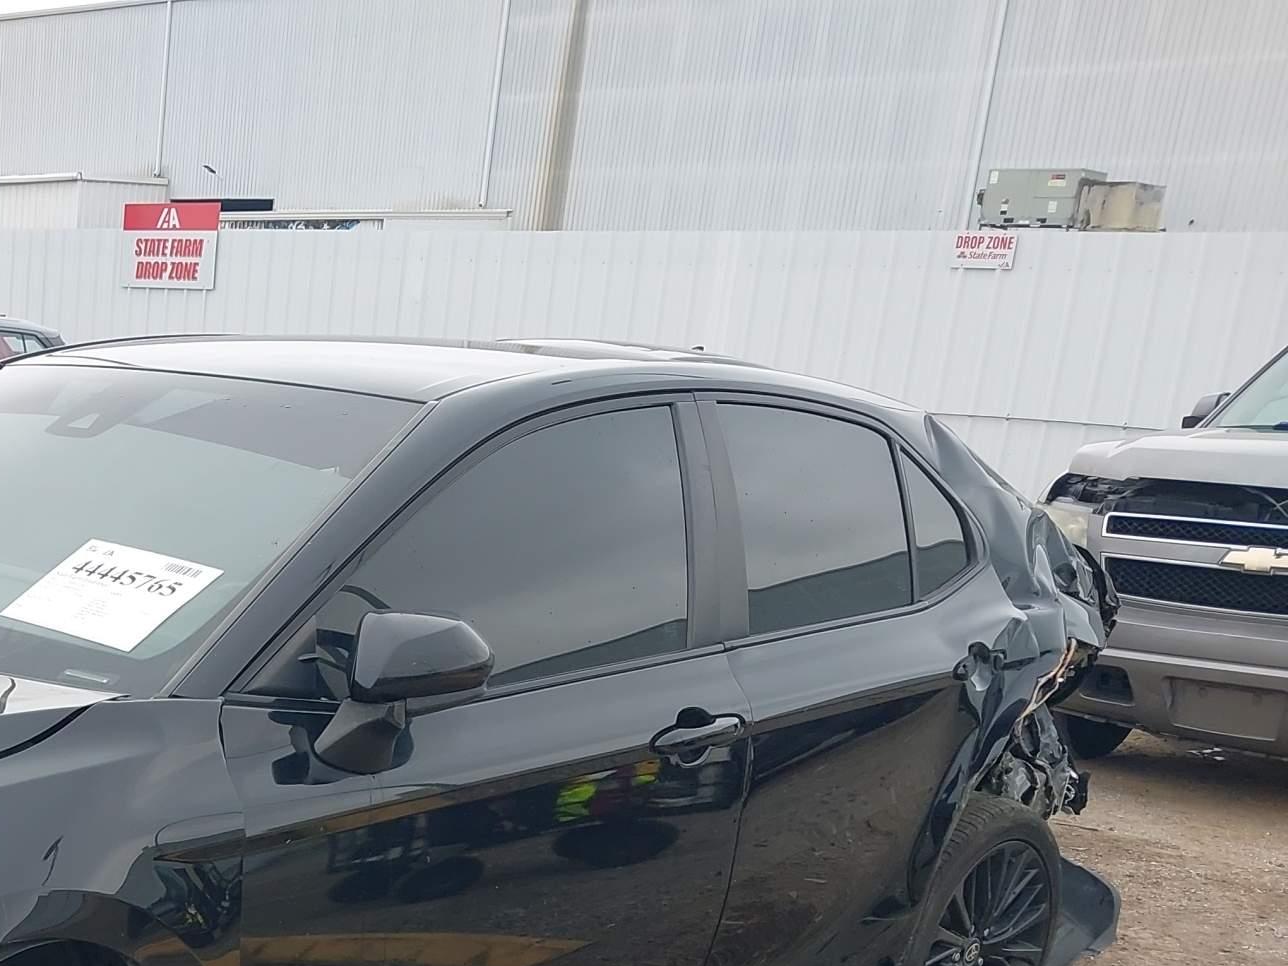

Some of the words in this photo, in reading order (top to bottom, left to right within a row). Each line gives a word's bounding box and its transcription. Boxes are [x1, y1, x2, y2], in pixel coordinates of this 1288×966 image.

[134, 238, 170, 258] STATE
[169, 238, 205, 258] FARM
[956, 236, 984, 249] DROP
[985, 236, 1015, 250] ZONE
[135, 261, 169, 280] DROP
[168, 261, 200, 281] ZONE
[71, 560, 184, 597] 44445765
